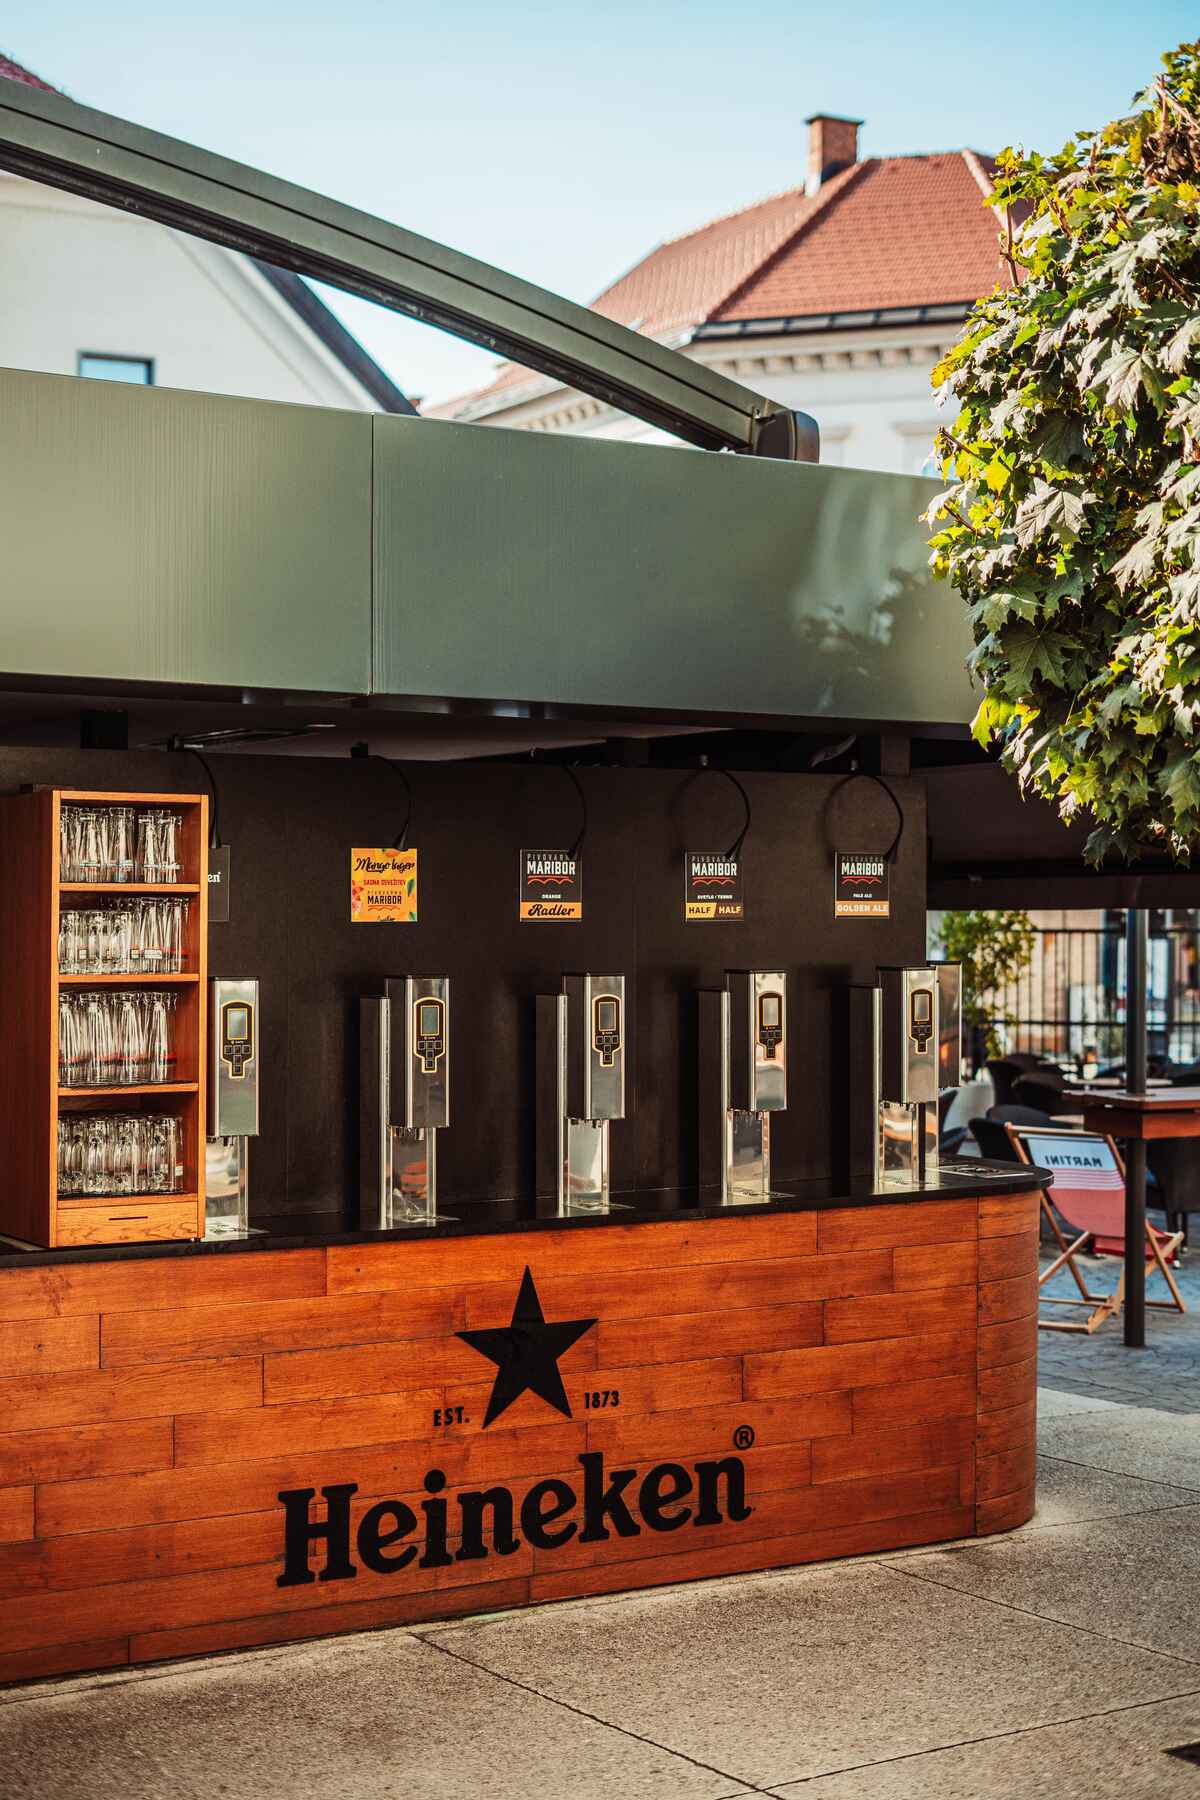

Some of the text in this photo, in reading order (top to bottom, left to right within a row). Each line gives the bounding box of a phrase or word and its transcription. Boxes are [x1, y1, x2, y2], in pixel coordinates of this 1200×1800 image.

[354, 857, 416, 873] Mango lager
[527, 861, 576, 875] MARIBOR
[692, 863, 737, 876] MARIBOR
[841, 863, 884, 876] MARIBOR
[368, 895, 402, 905] MARIBOR
[528, 904, 575, 917] Radler
[719, 906, 742, 914] HALF
[836, 904, 888, 912] GOLDEN ALE
[433, 1390, 620, 1427] EST. 1873
